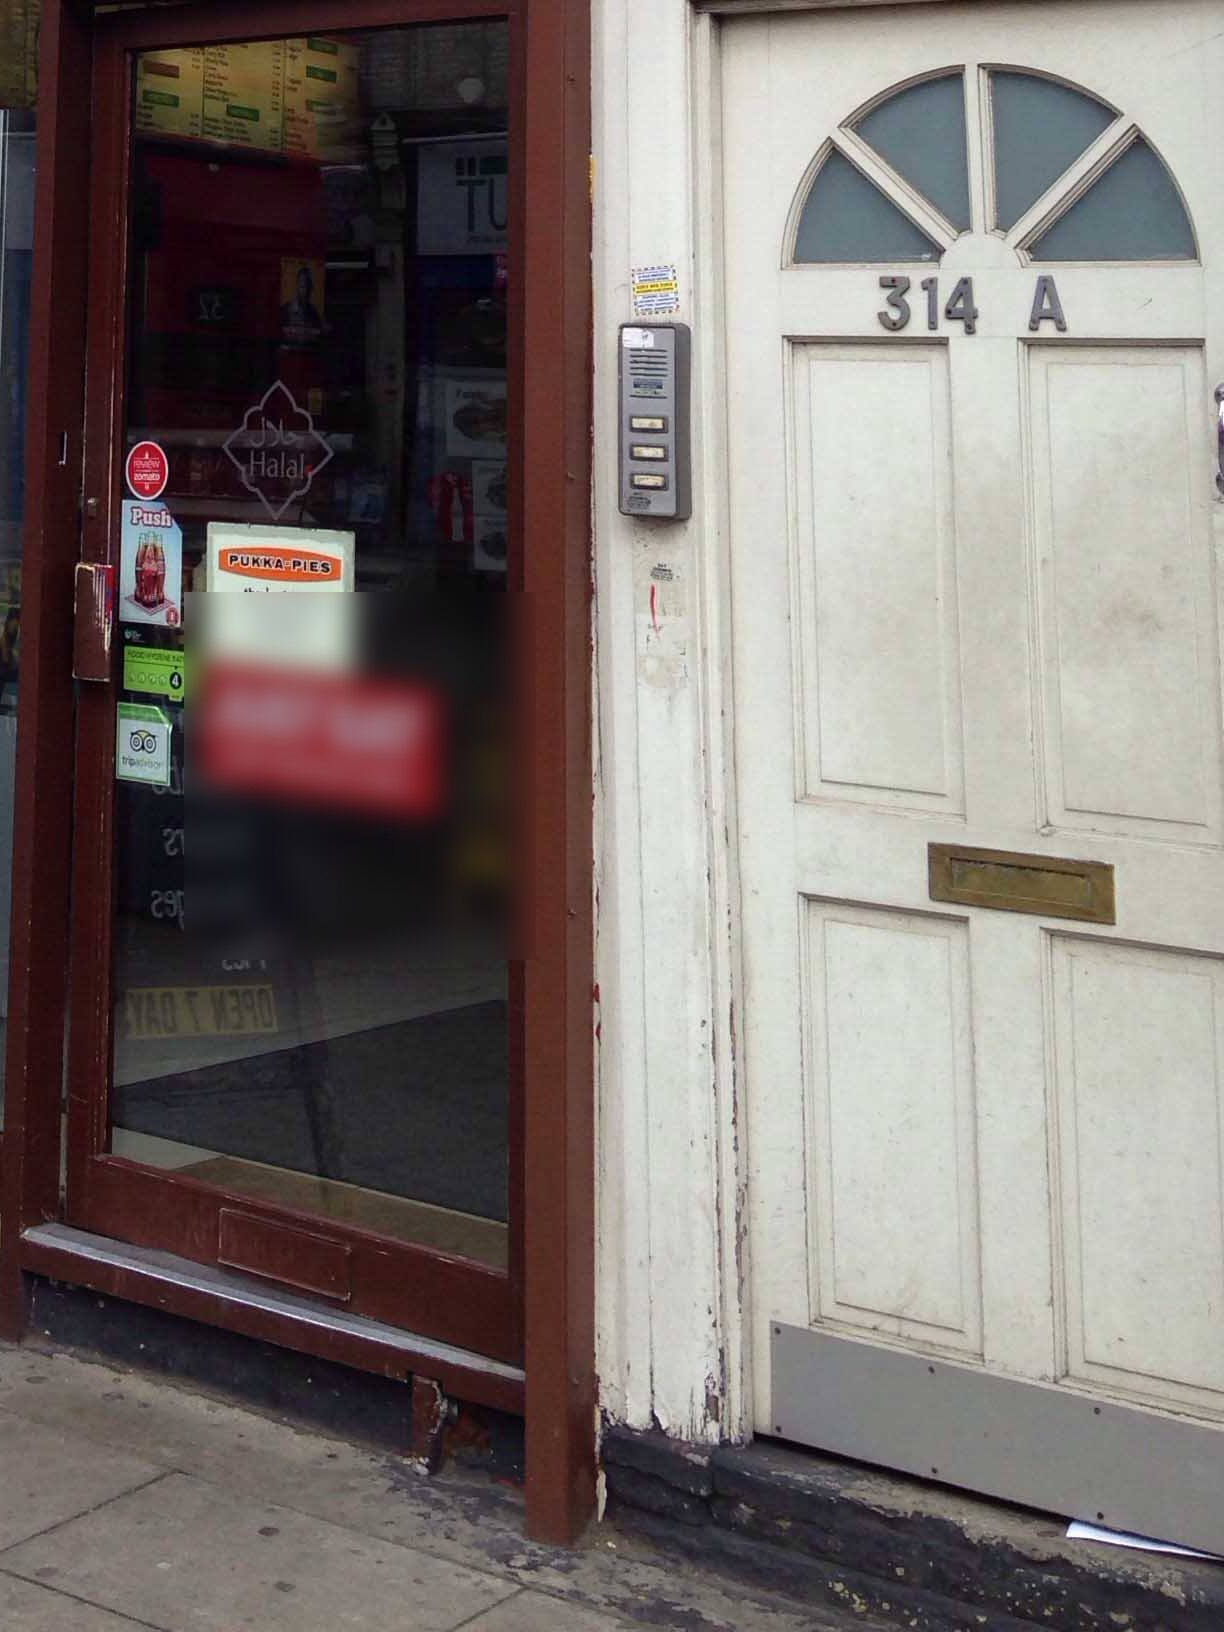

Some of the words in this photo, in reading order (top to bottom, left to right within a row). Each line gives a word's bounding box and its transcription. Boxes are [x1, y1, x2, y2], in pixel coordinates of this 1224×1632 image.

[878, 275, 978, 335] 314
[1028, 275, 1068, 332] A
[249, 450, 305, 481] Halal
[131, 506, 173, 528] Push
